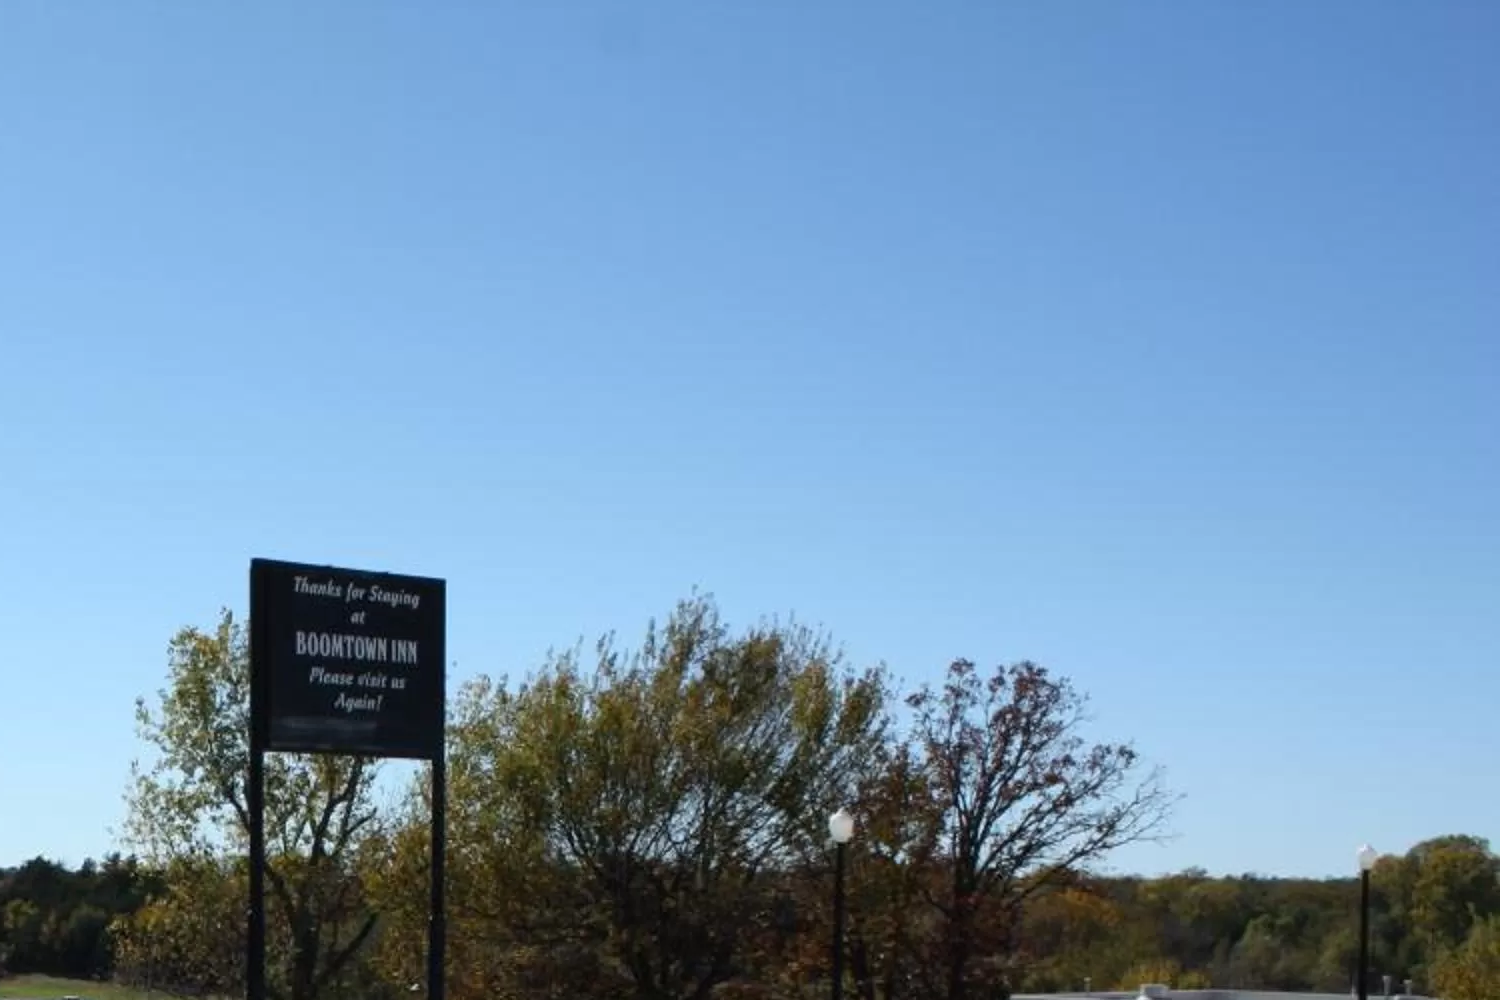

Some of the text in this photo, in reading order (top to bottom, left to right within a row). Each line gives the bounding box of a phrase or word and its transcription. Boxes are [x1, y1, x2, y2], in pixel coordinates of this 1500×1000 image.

[294, 576, 420, 609] Thanks for Staying
[351, 612, 365, 625] at
[296, 631, 417, 664] BOOMTOWN INN
[310, 666, 405, 689] Please visit us
[334, 693, 383, 712] Again!
